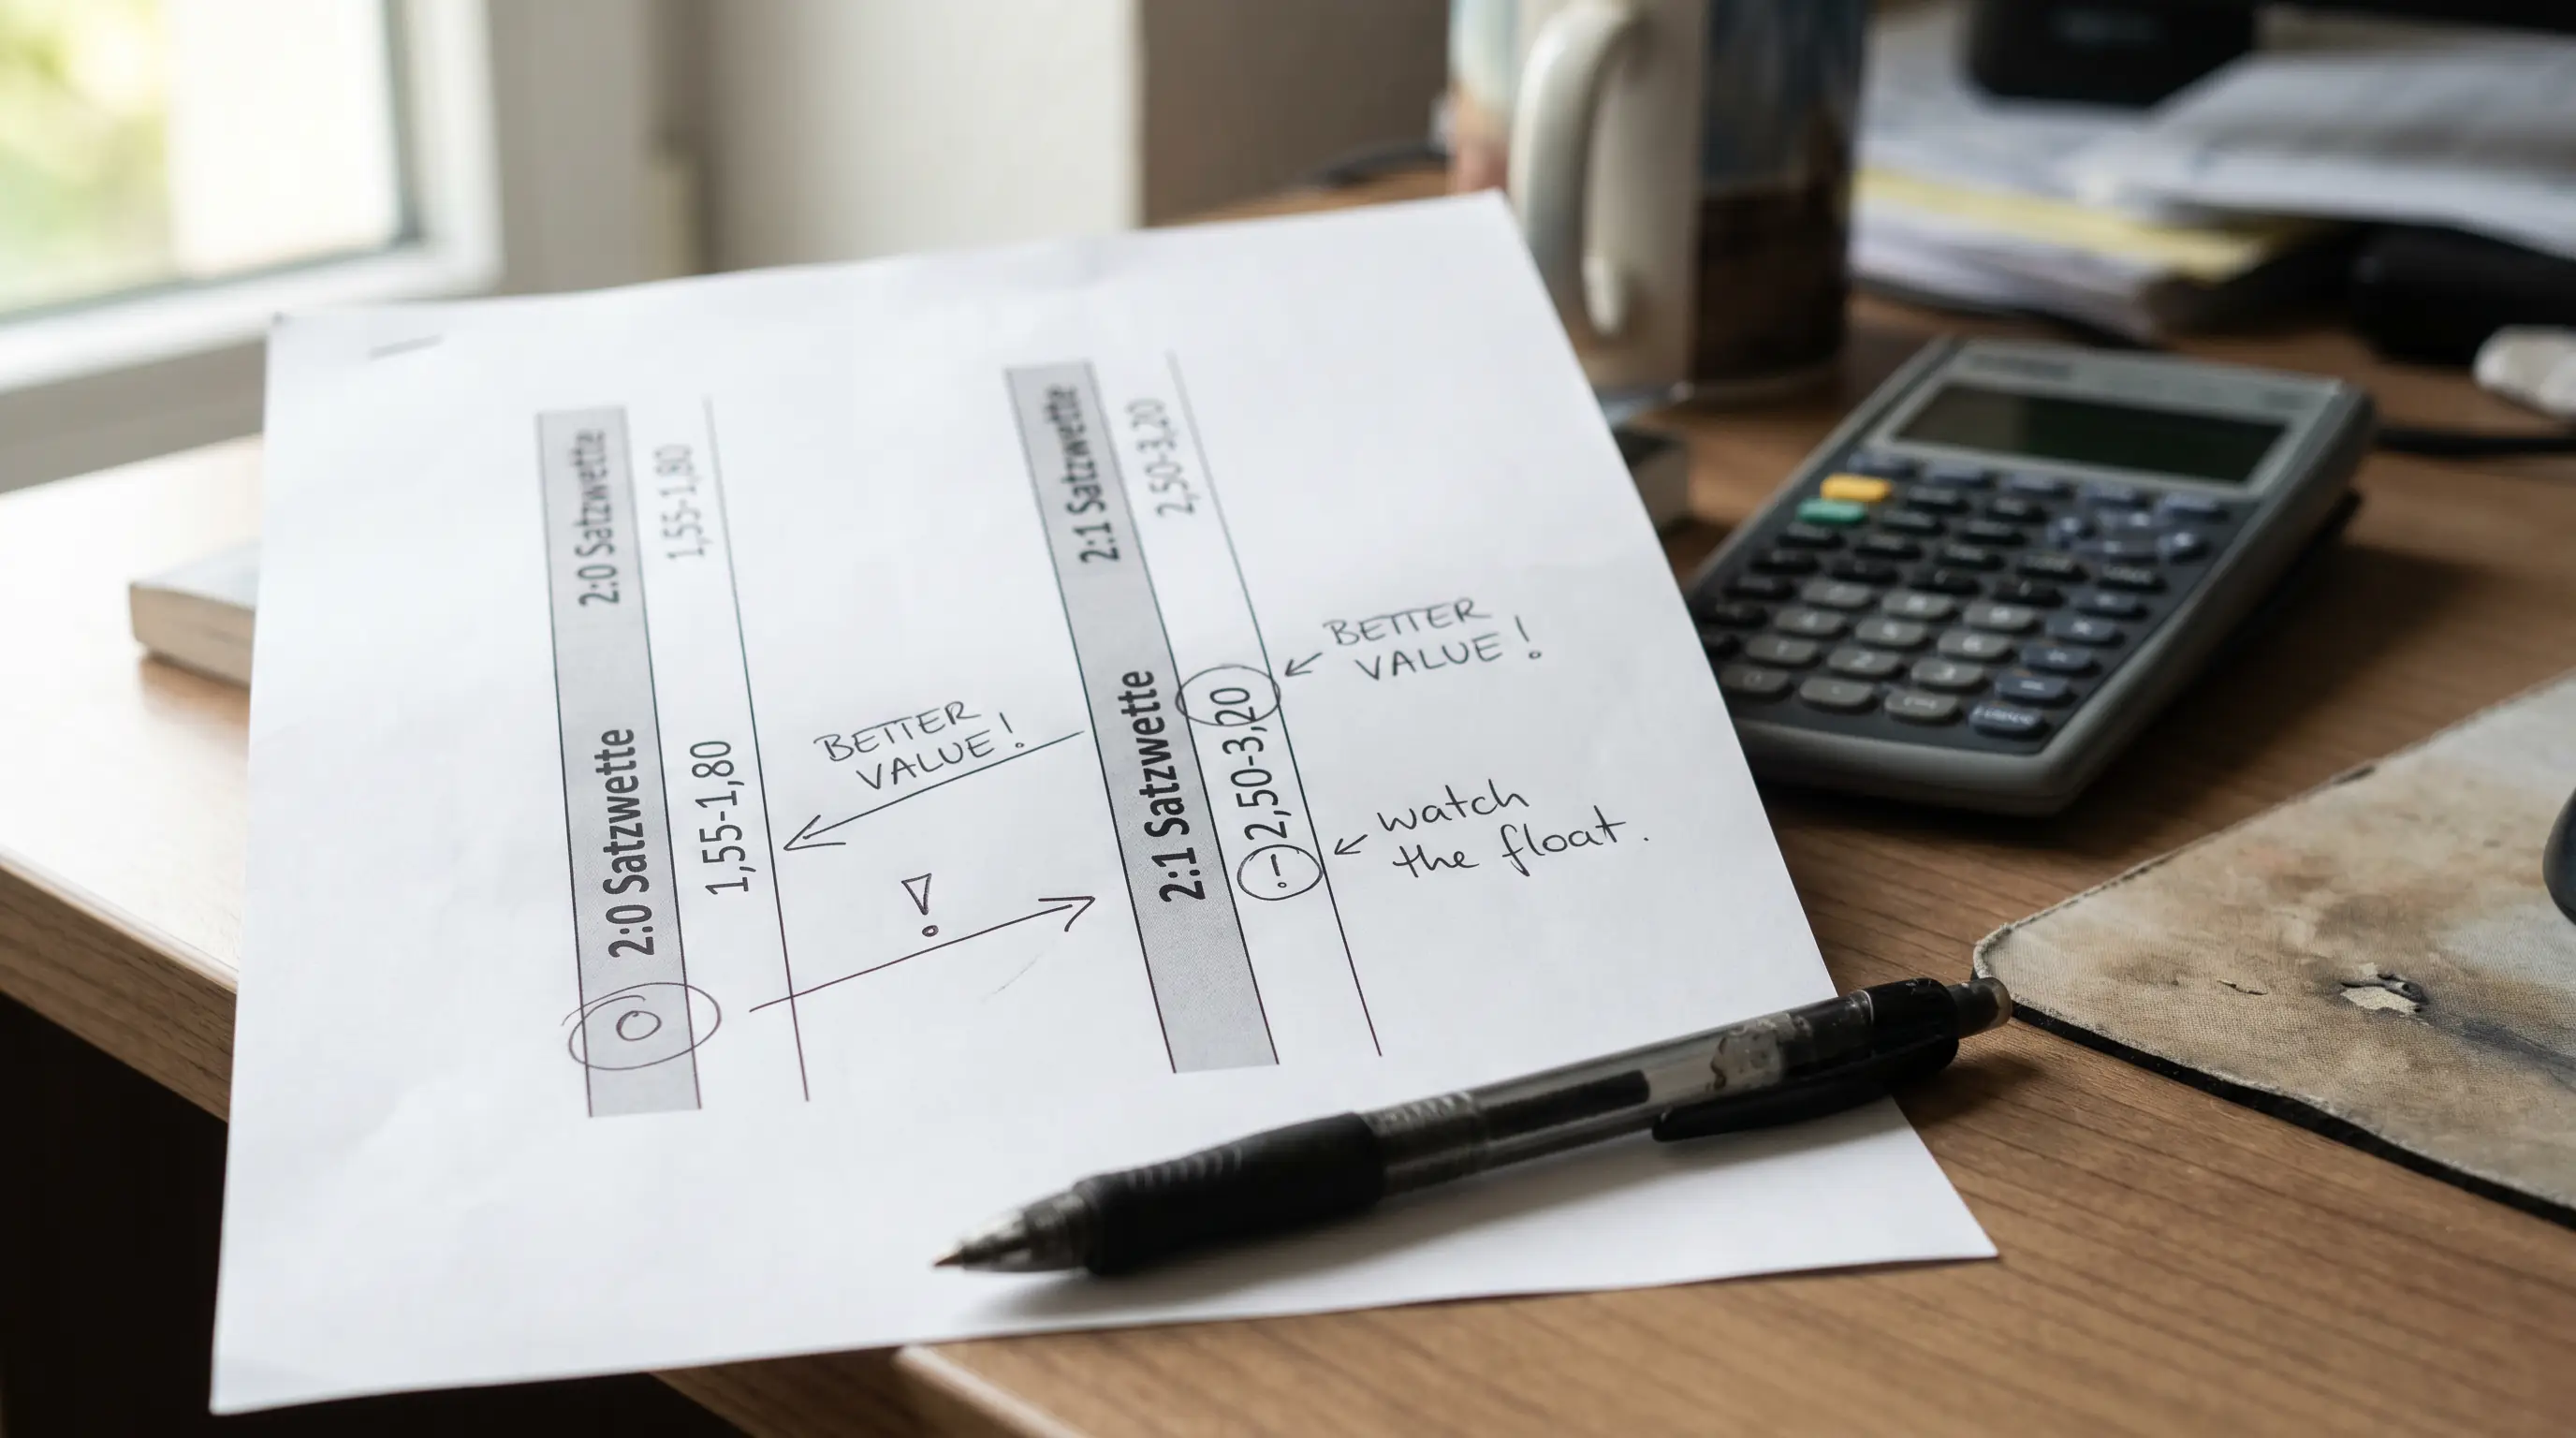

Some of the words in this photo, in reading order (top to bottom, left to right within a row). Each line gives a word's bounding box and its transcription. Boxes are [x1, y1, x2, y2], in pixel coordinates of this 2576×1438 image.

[571, 430, 616, 557] Satzwette
[1044, 385, 1106, 515] Satzwette
[1125, 398, 1200, 517] 2,50-3,20
[653, 443, 712, 560] 1,55-1,80
[1073, 521, 1120, 564] 2:1
[577, 564, 620, 607] 2:0
[1323, 598, 1492, 645] BETTER
[813, 701, 981, 761] BETTER
[1118, 670, 1190, 837] Satzwette
[1209, 687, 1292, 840] 2,50-3,20
[594, 729, 650, 894] Satzwette
[690, 741, 756, 894] 1,55-1,80
[1377, 778, 1530, 832] watch
[1392, 844, 1480, 877] the
[1500, 805, 1649, 877] float.
[1151, 847, 1206, 902] 2:1
[606, 904, 654, 958] 2:0
